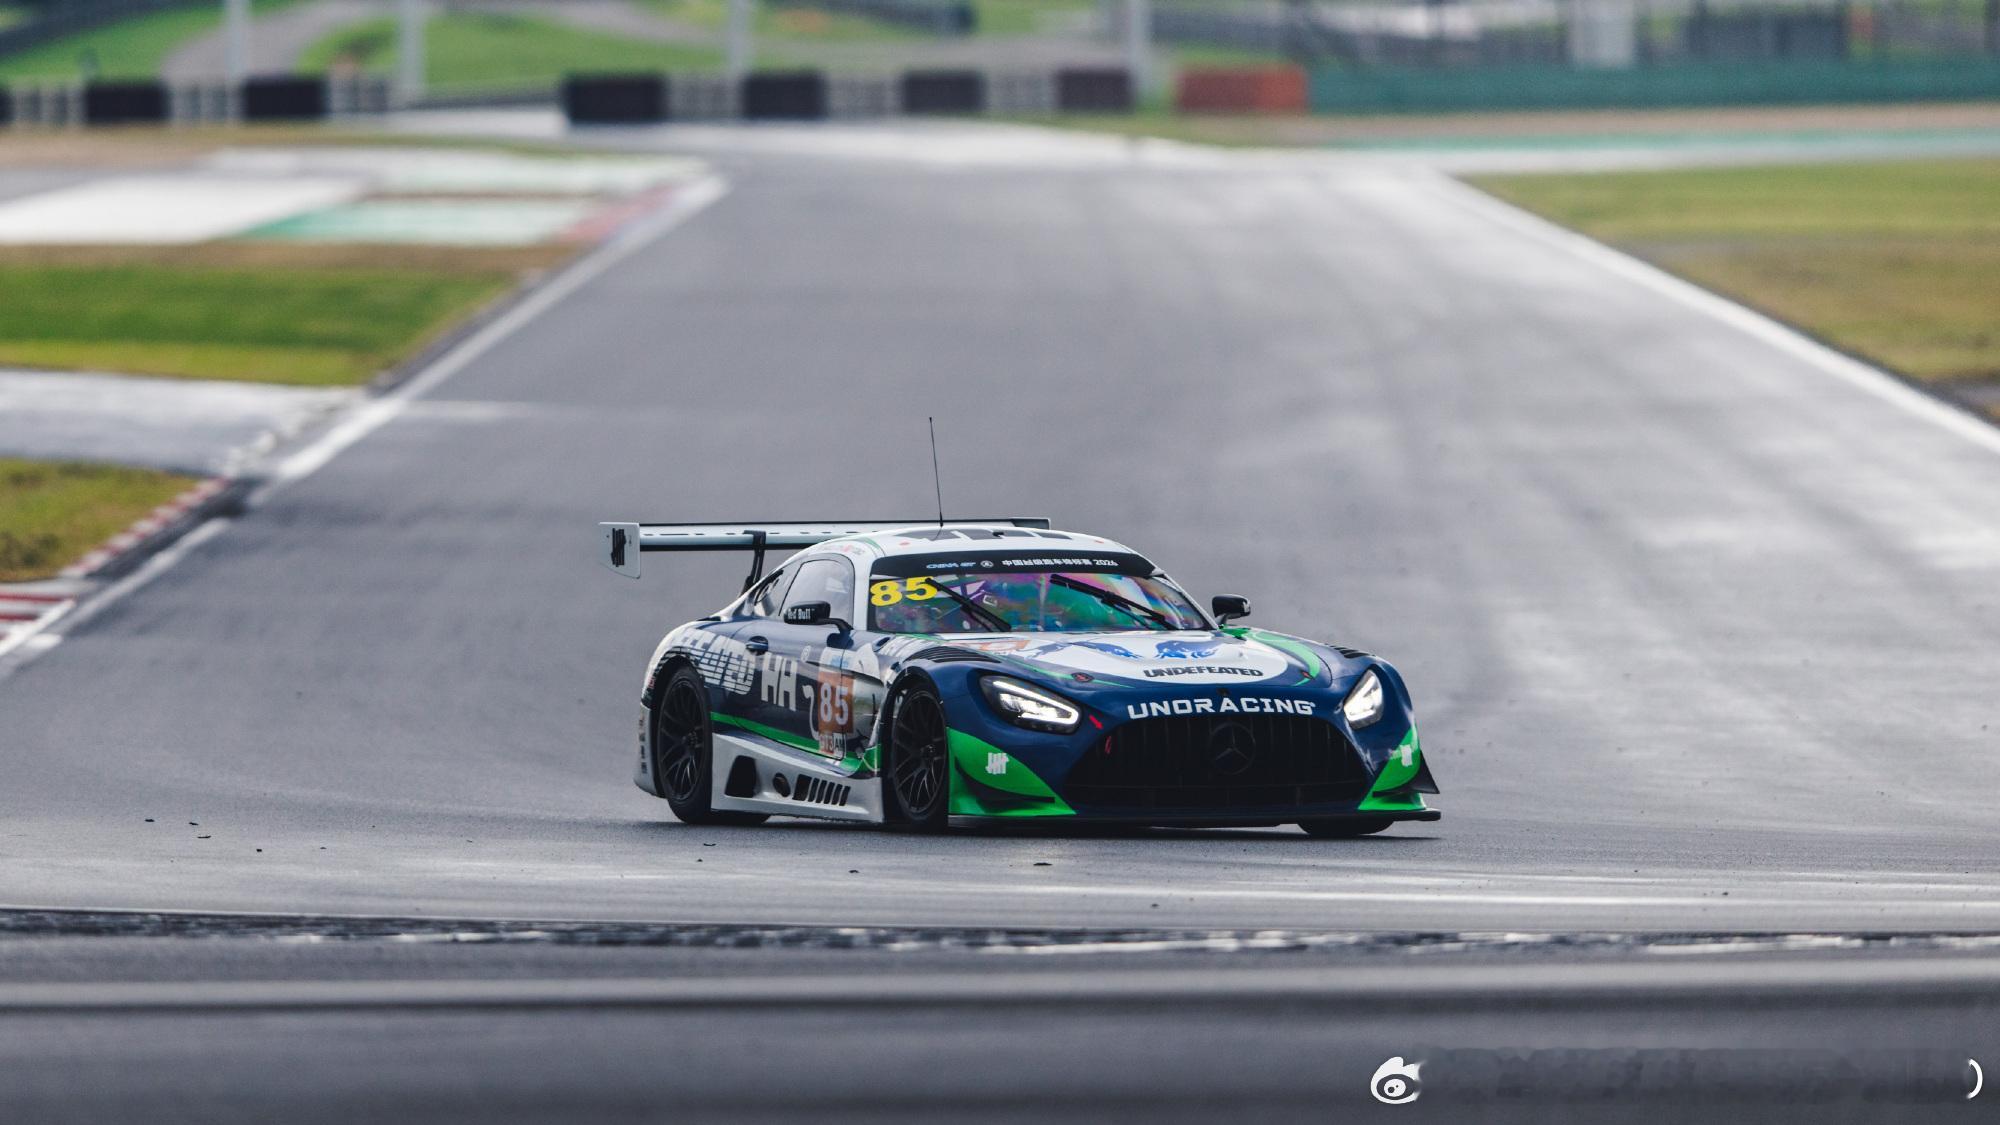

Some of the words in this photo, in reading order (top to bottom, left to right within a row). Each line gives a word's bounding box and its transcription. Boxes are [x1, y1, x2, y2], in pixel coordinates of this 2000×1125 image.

[870, 576, 937, 606] 85
[1143, 666, 1263, 677] UNDEFEATED
[820, 682, 849, 726] 85
[1127, 697, 1314, 719] UNORACING
